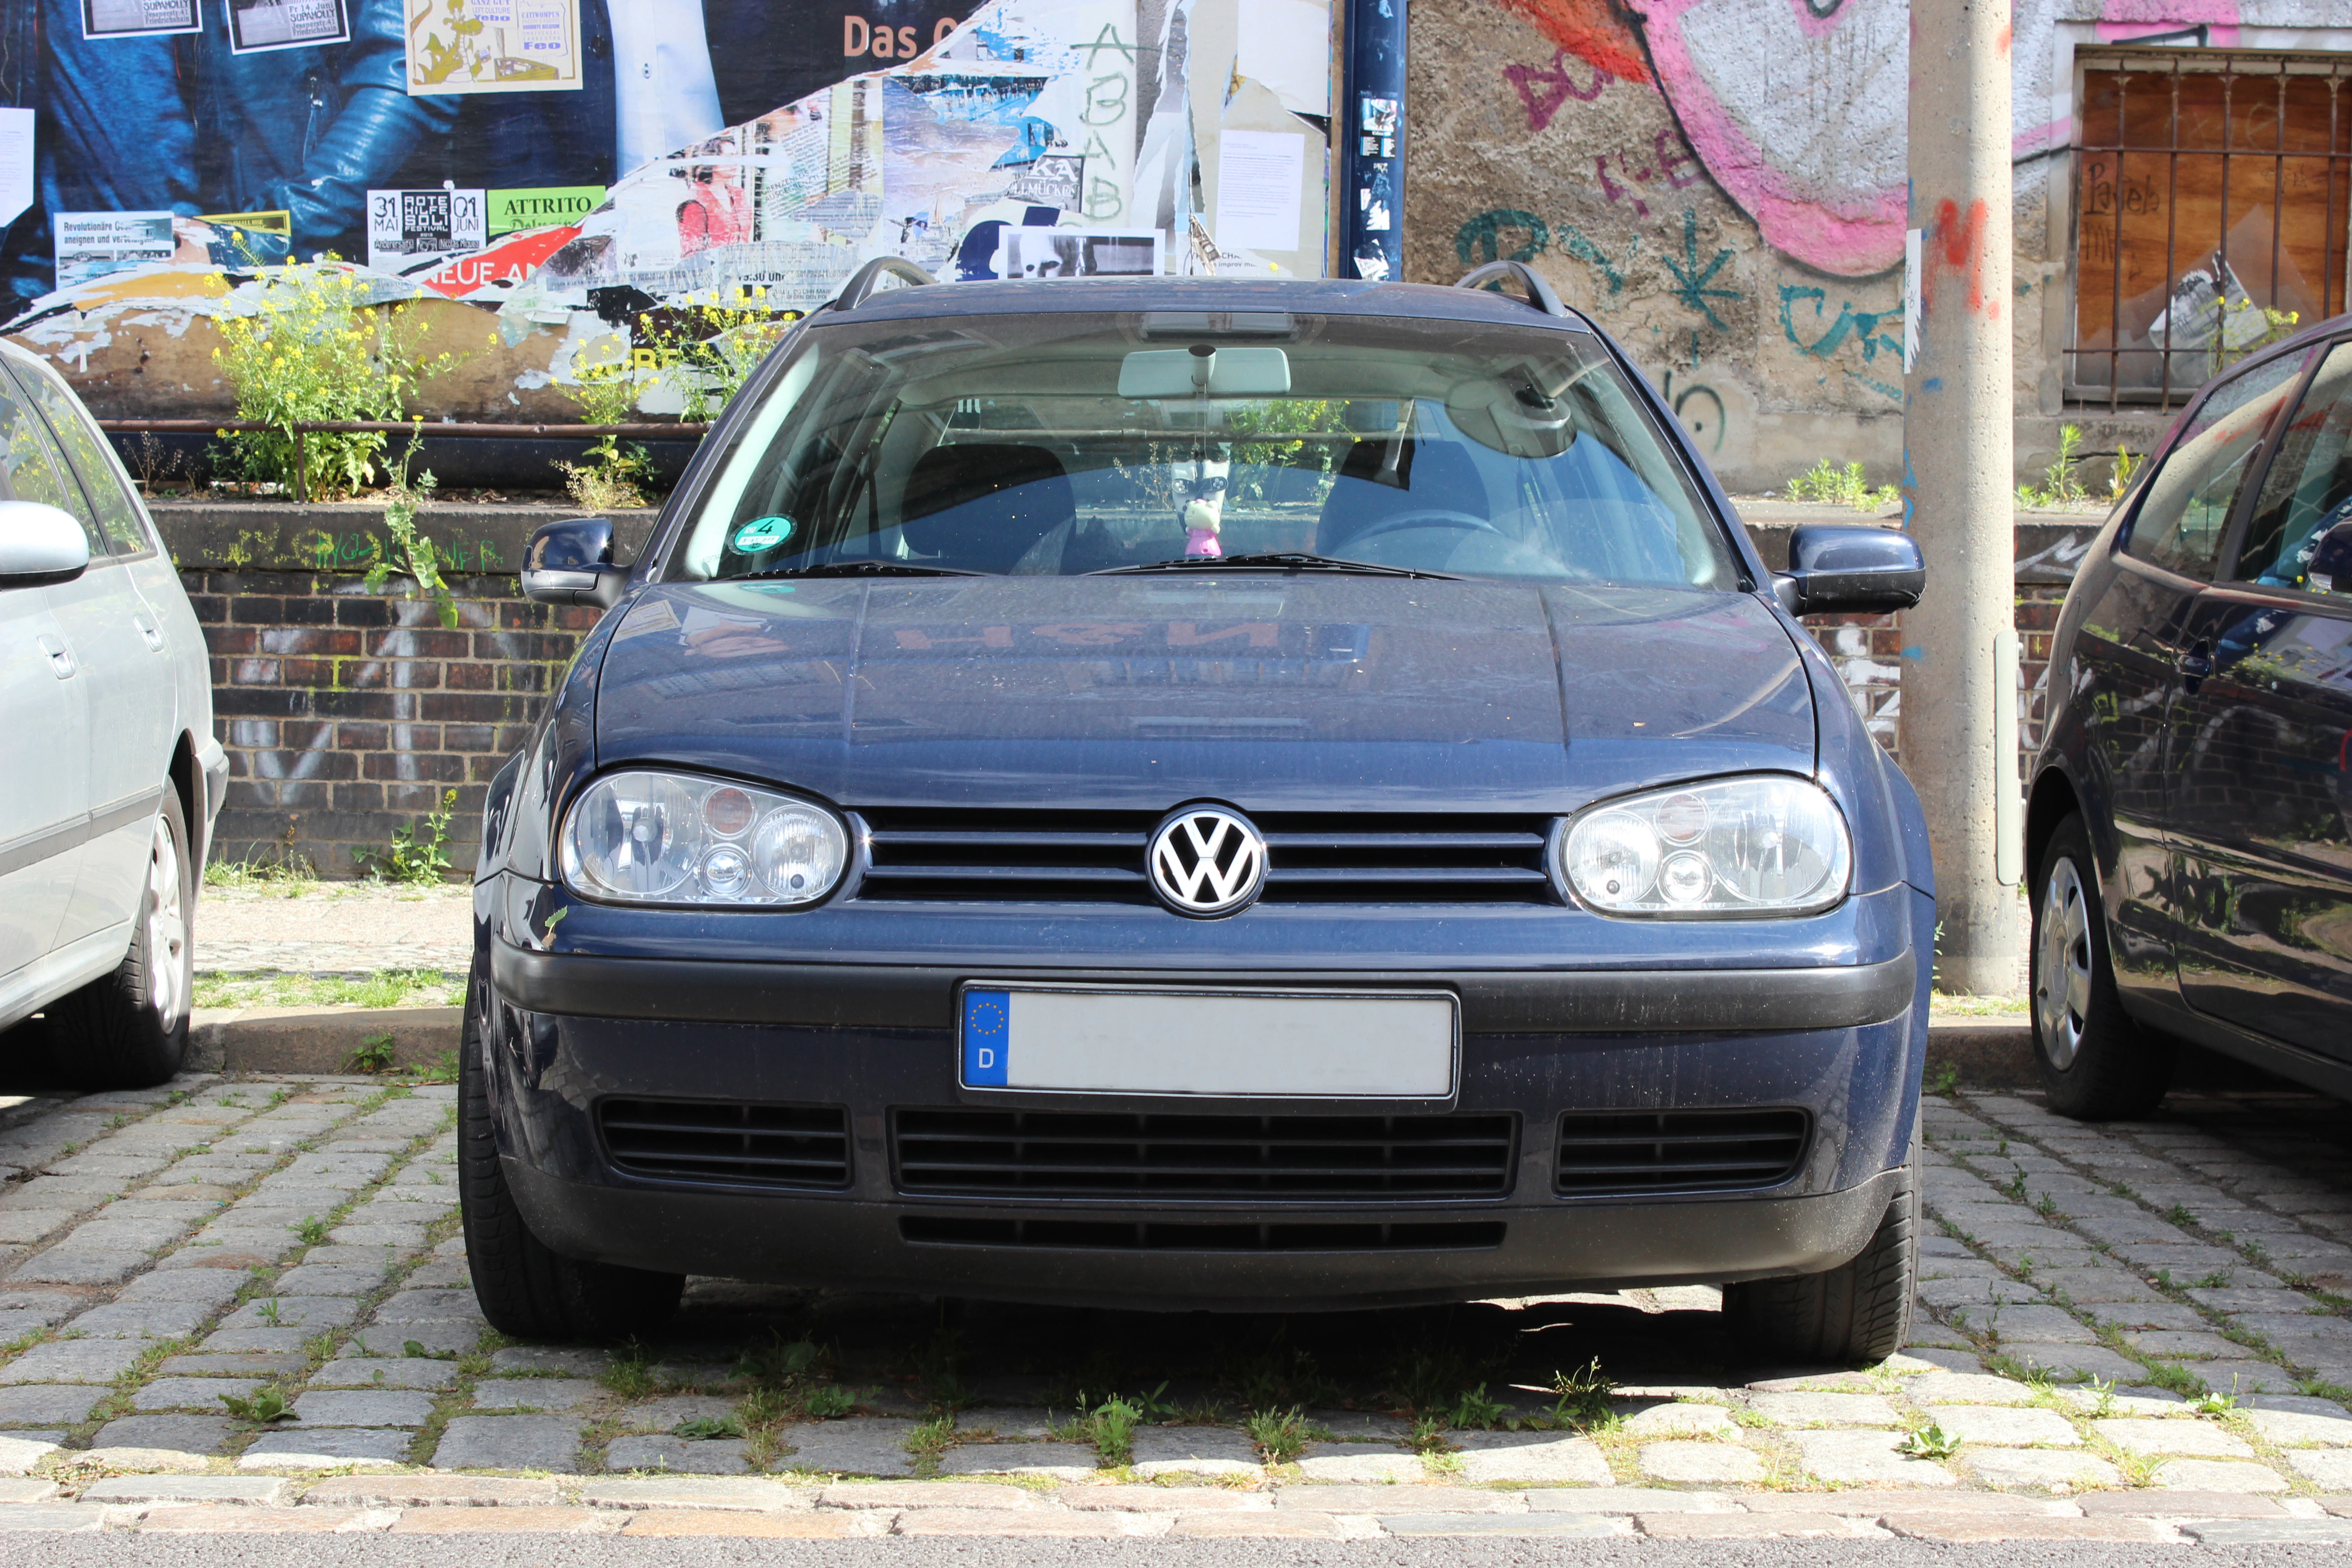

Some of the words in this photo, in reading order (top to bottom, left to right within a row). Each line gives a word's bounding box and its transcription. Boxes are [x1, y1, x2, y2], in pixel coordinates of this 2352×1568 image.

[290, 8, 335, 22] SUPAMOLLY
[844, 15, 917, 59] Das
[374, 196, 395, 218] 31
[454, 196, 476, 218] 01
[405, 206, 448, 215] HILFE
[504, 196, 592, 216] ATTRITO
[64, 221, 112, 232] Revolutionäre
[405, 215, 448, 225] SOLI
[64, 235, 95, 246] aneignen
[98, 235, 110, 244] und
[757, 519, 775, 534] 4
[978, 1048, 995, 1069] D
